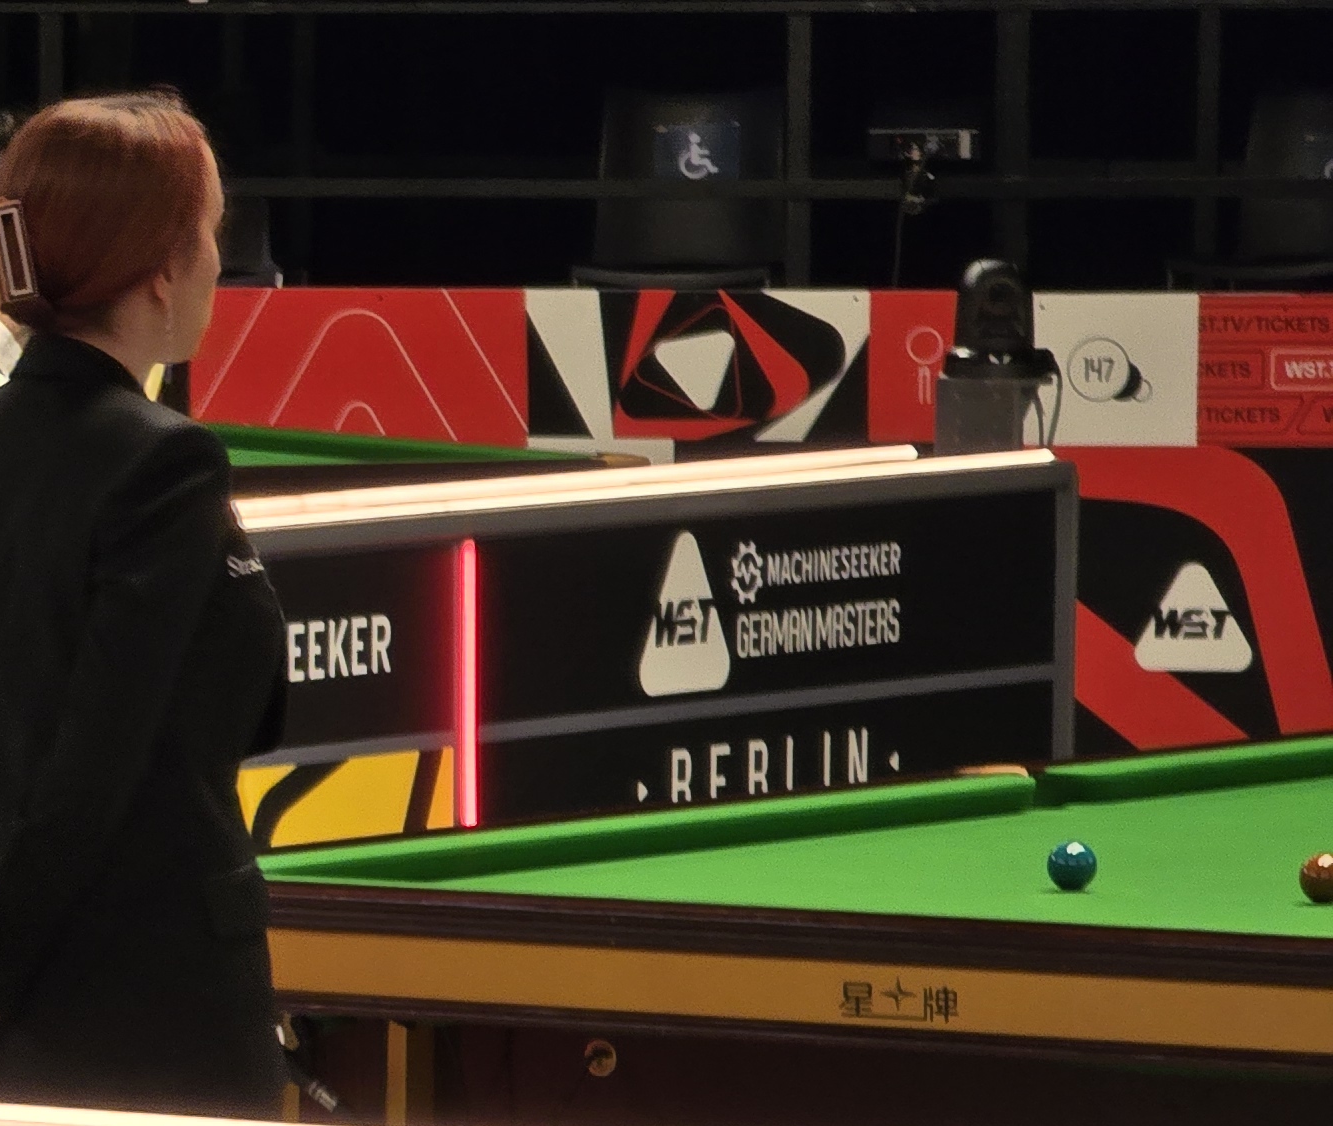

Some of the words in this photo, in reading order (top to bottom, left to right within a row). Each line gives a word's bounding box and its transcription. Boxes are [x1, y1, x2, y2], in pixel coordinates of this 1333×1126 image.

[1083, 357, 1115, 383] 147
[766, 541, 902, 586] MACHINESEEKER
[651, 599, 719, 649] WST
[736, 604, 813, 659] GERMAN
[815, 598, 901, 651] MASTERS
[1152, 608, 1232, 639] WST
[287, 614, 392, 683] EEKER
